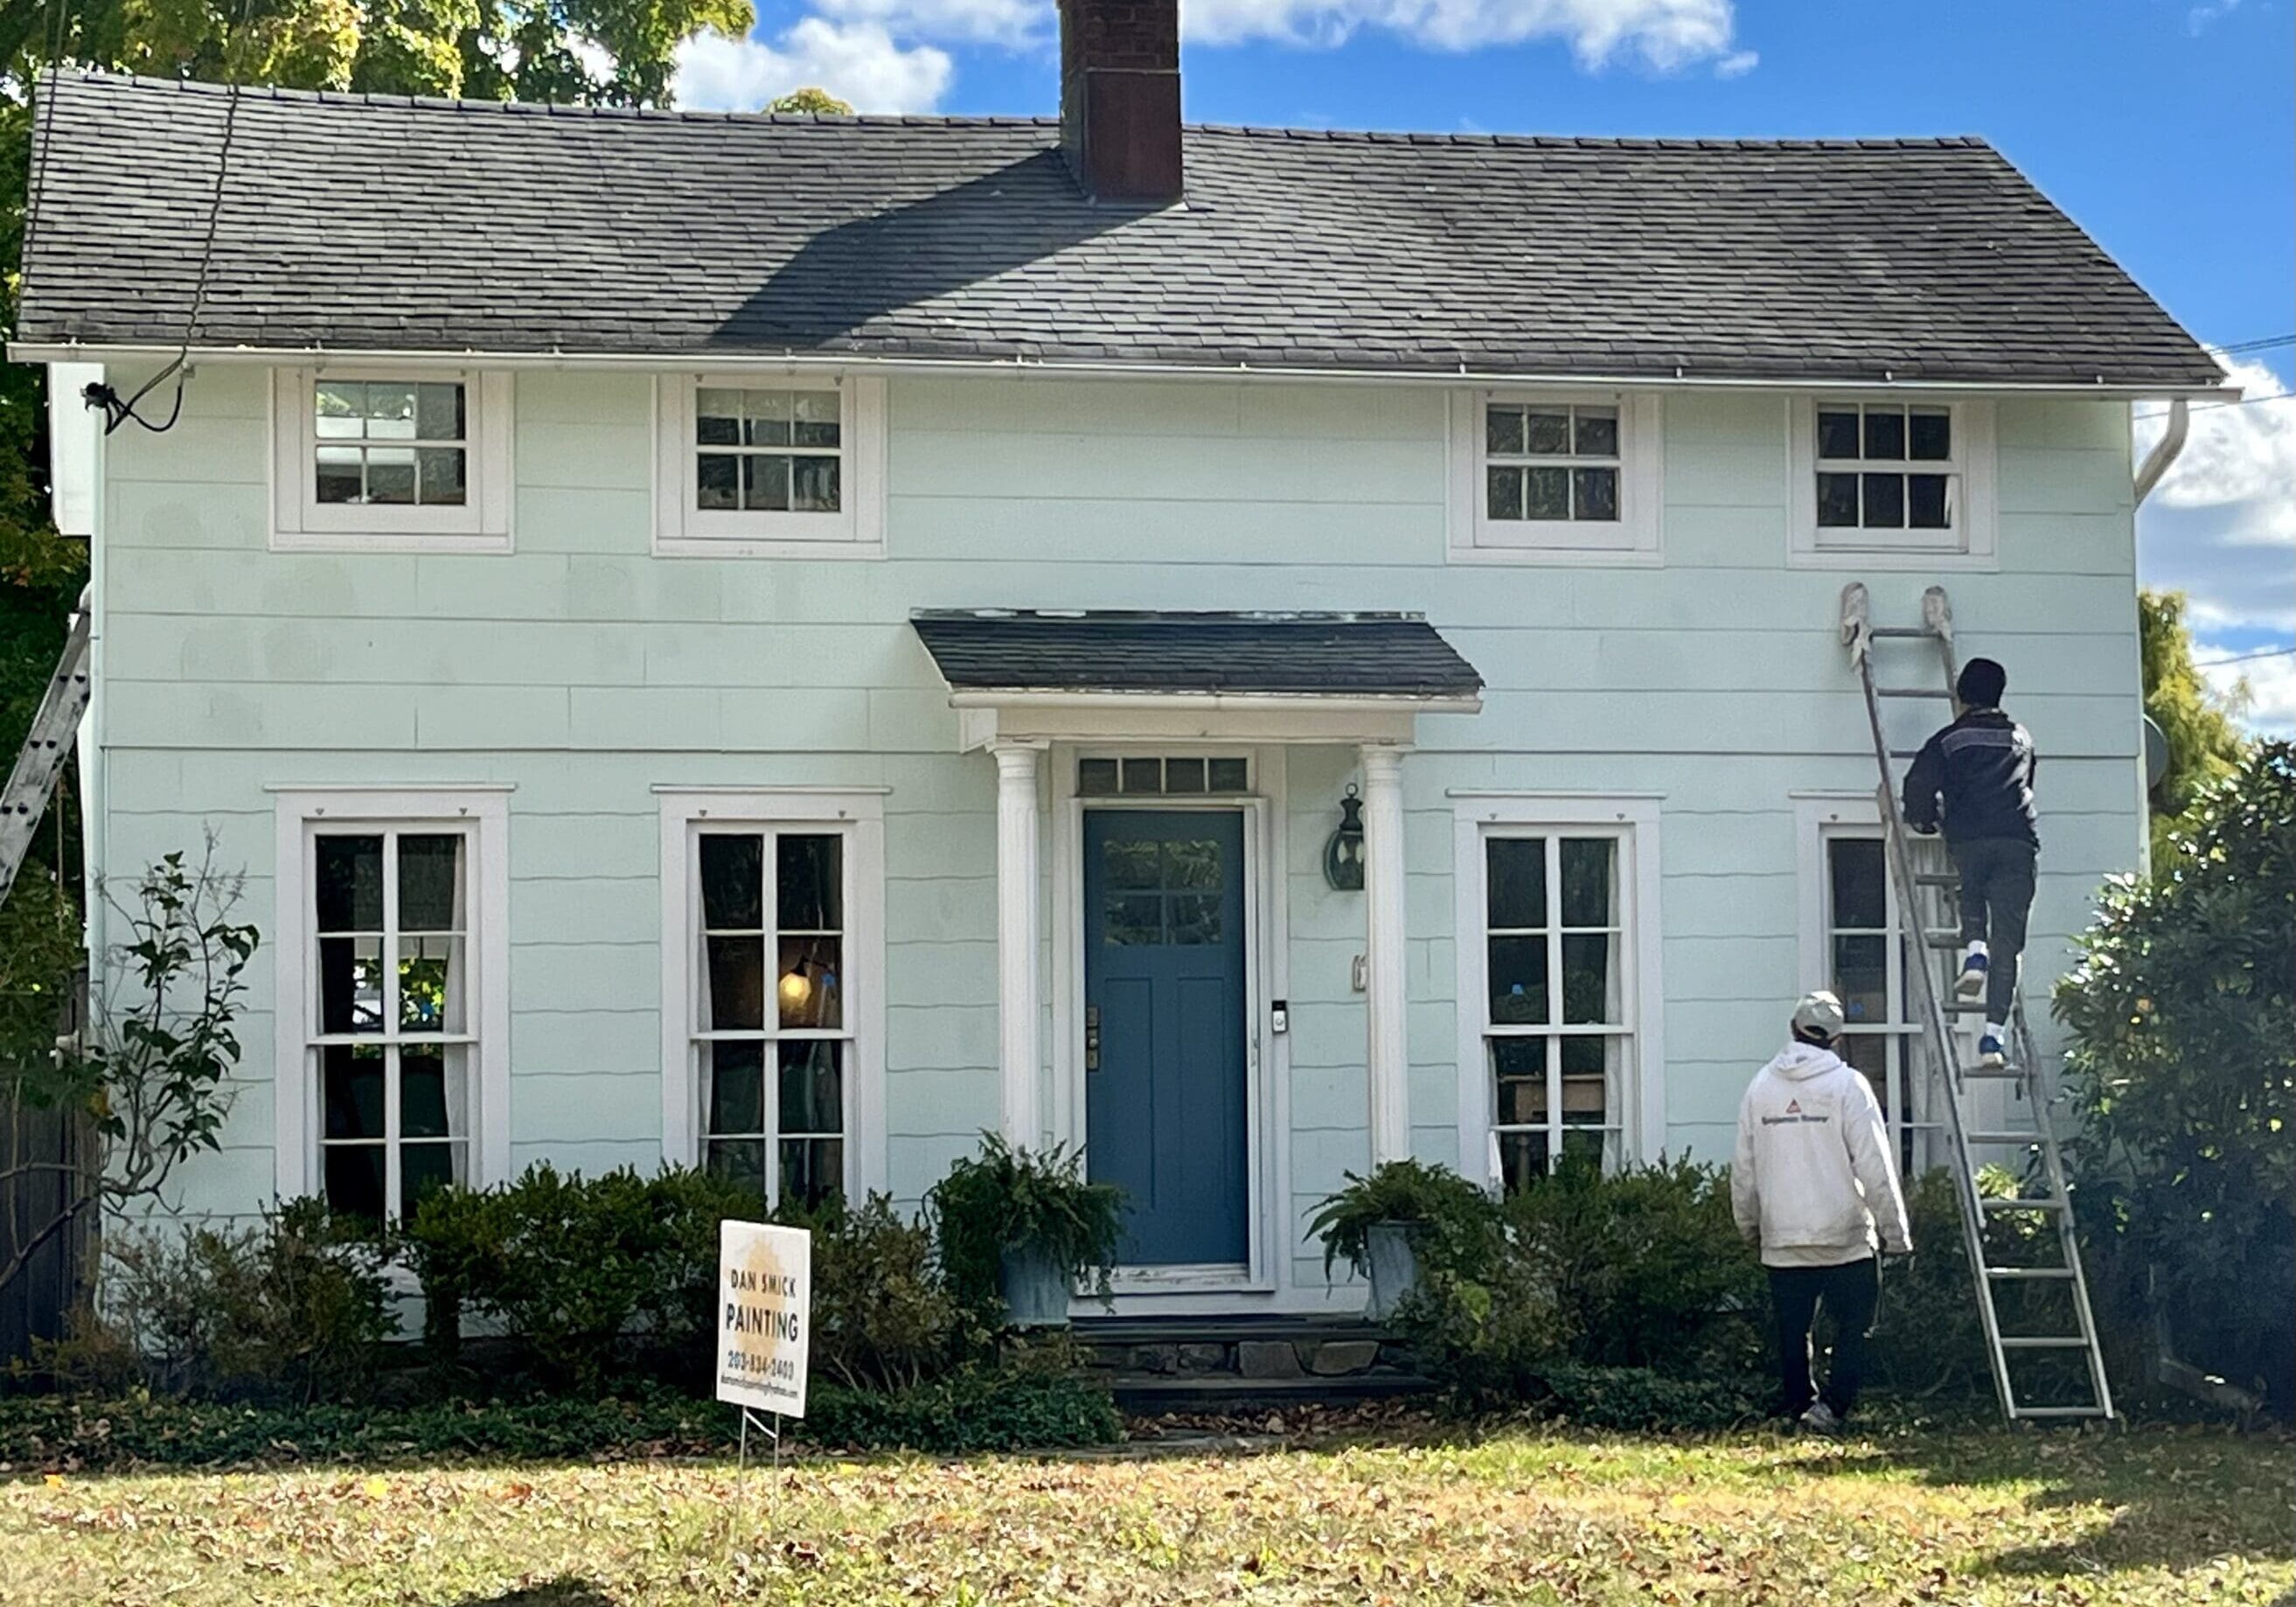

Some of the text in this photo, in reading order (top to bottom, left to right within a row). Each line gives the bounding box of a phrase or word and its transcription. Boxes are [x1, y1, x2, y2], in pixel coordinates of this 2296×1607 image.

[731, 1269, 796, 1298] DAN SMICK
[726, 1303, 798, 1342] PAINTING
